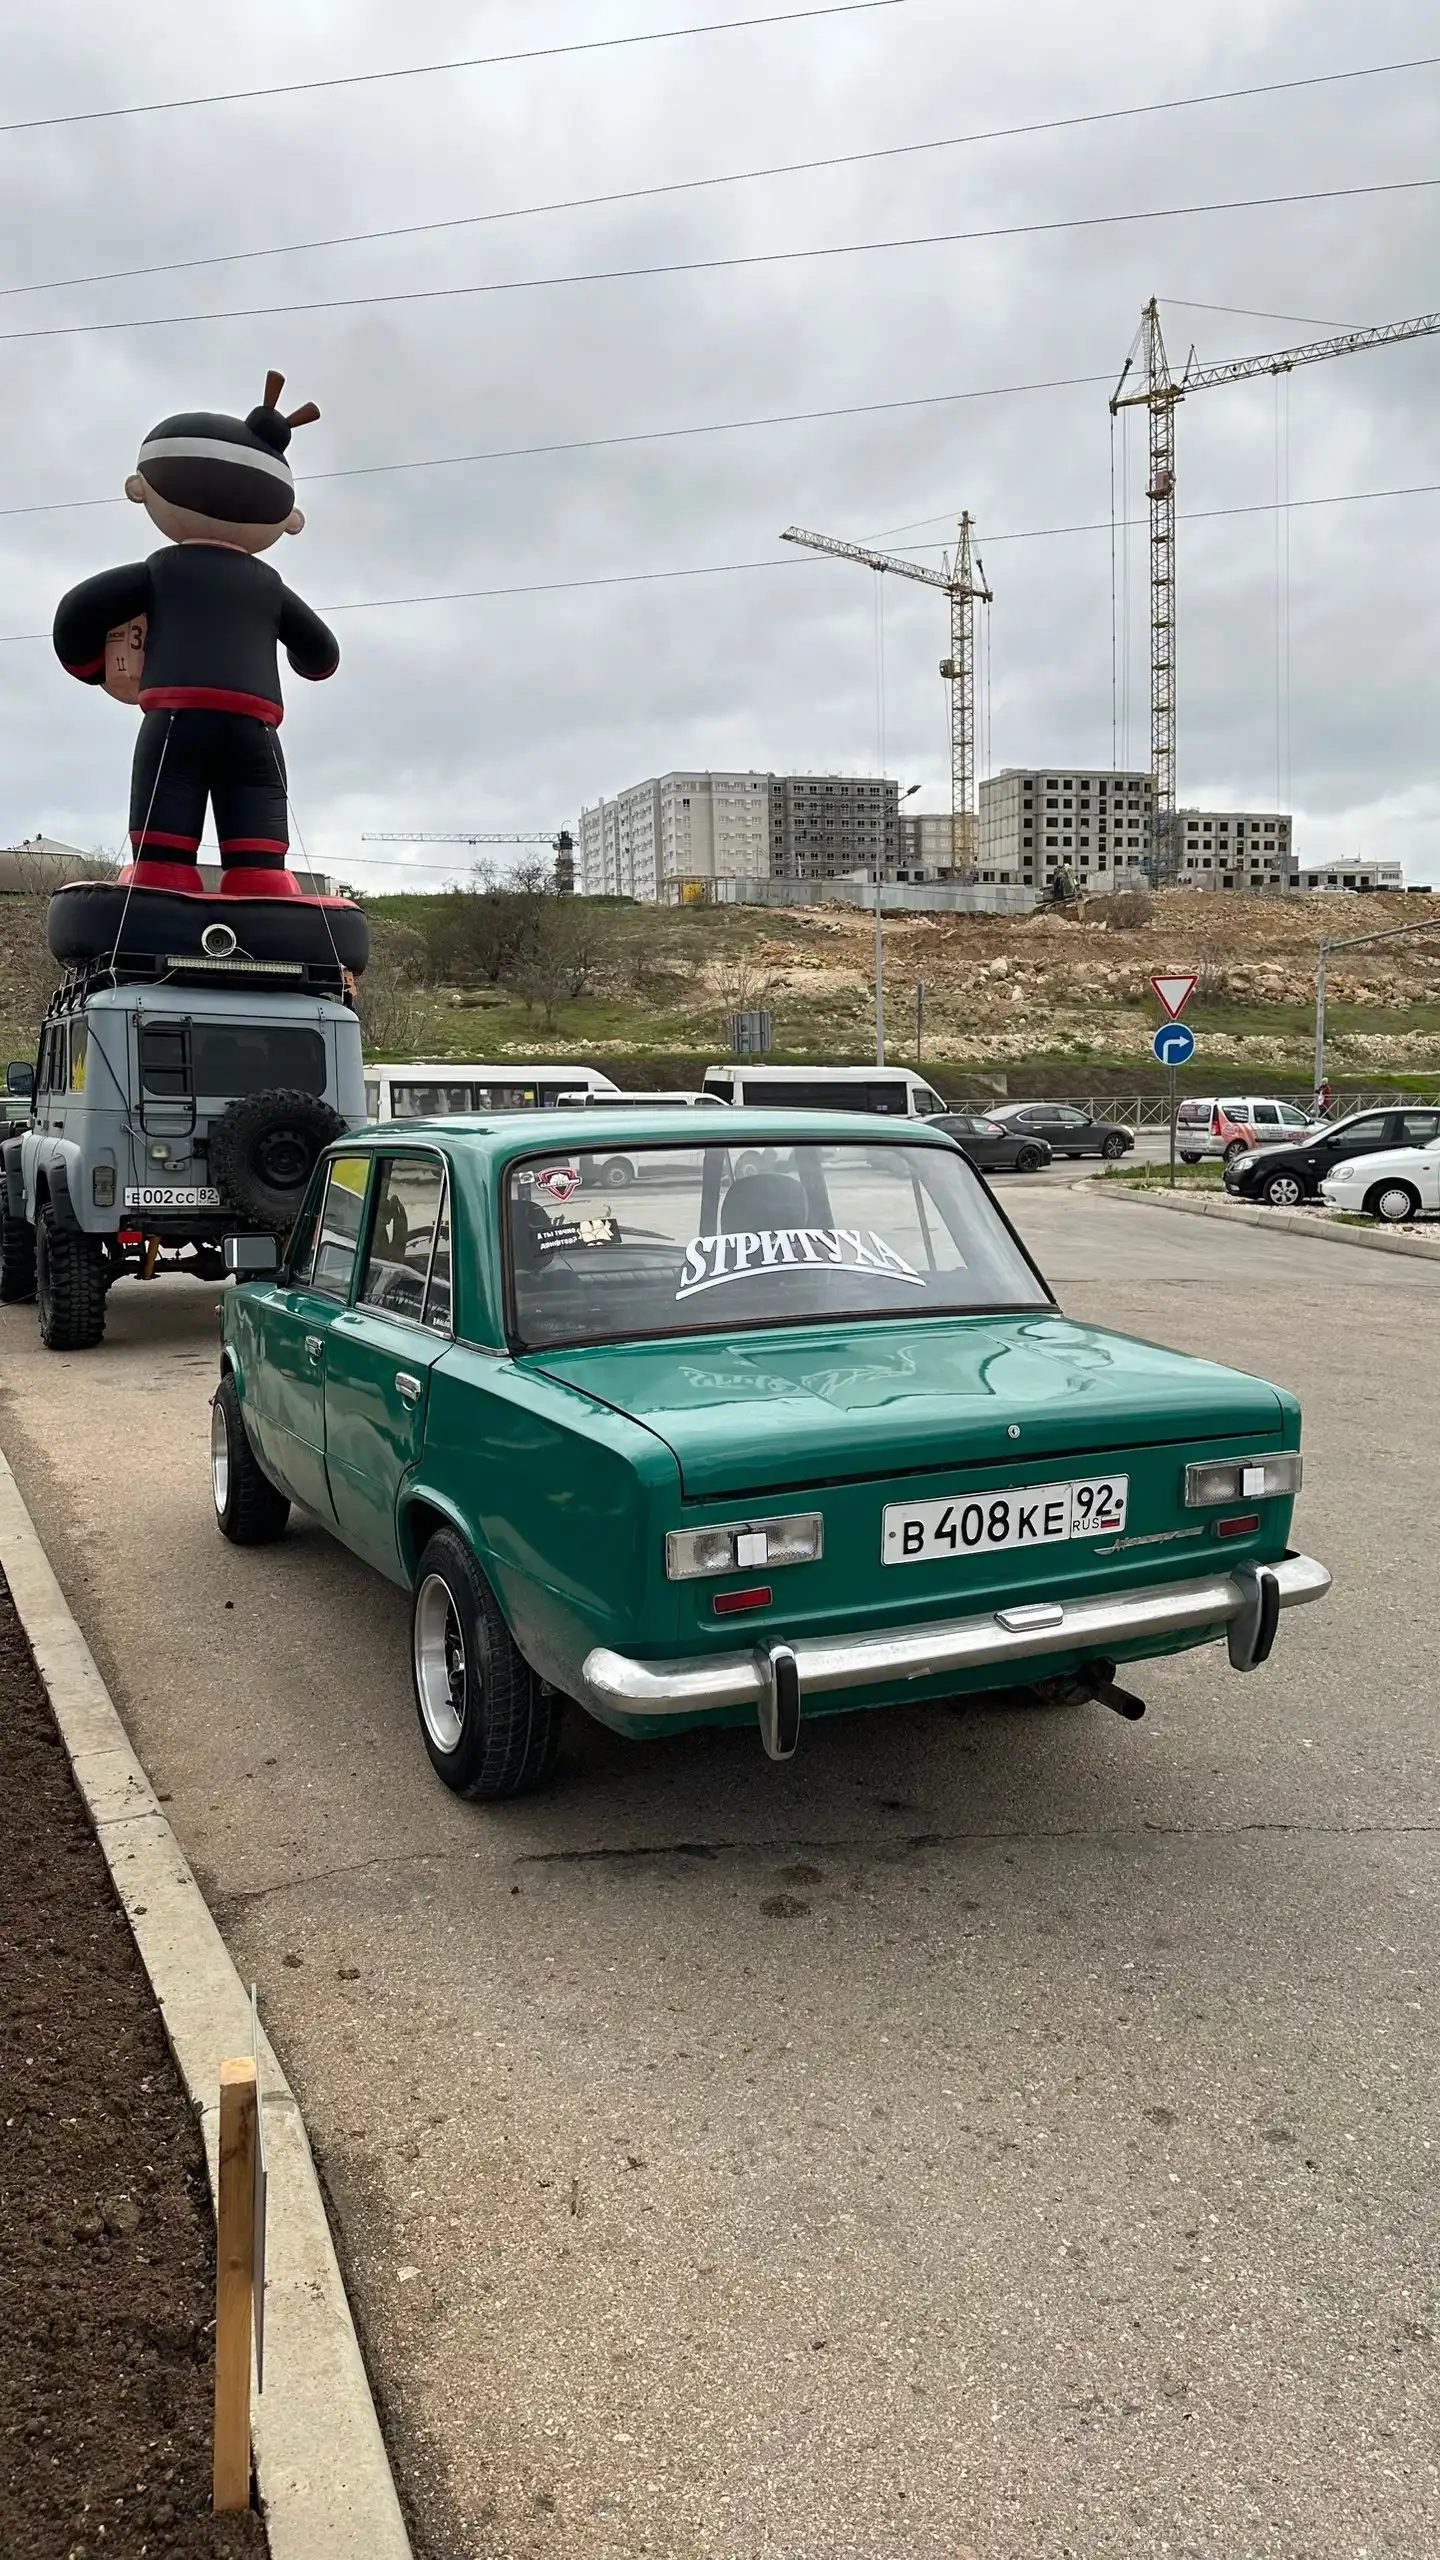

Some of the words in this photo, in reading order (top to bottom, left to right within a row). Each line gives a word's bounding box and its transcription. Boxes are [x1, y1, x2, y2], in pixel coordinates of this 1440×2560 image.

[200, 1189, 215, 1200] 82
[1076, 1484, 1114, 1519] 92
[1072, 1517, 1100, 1533] RUS
